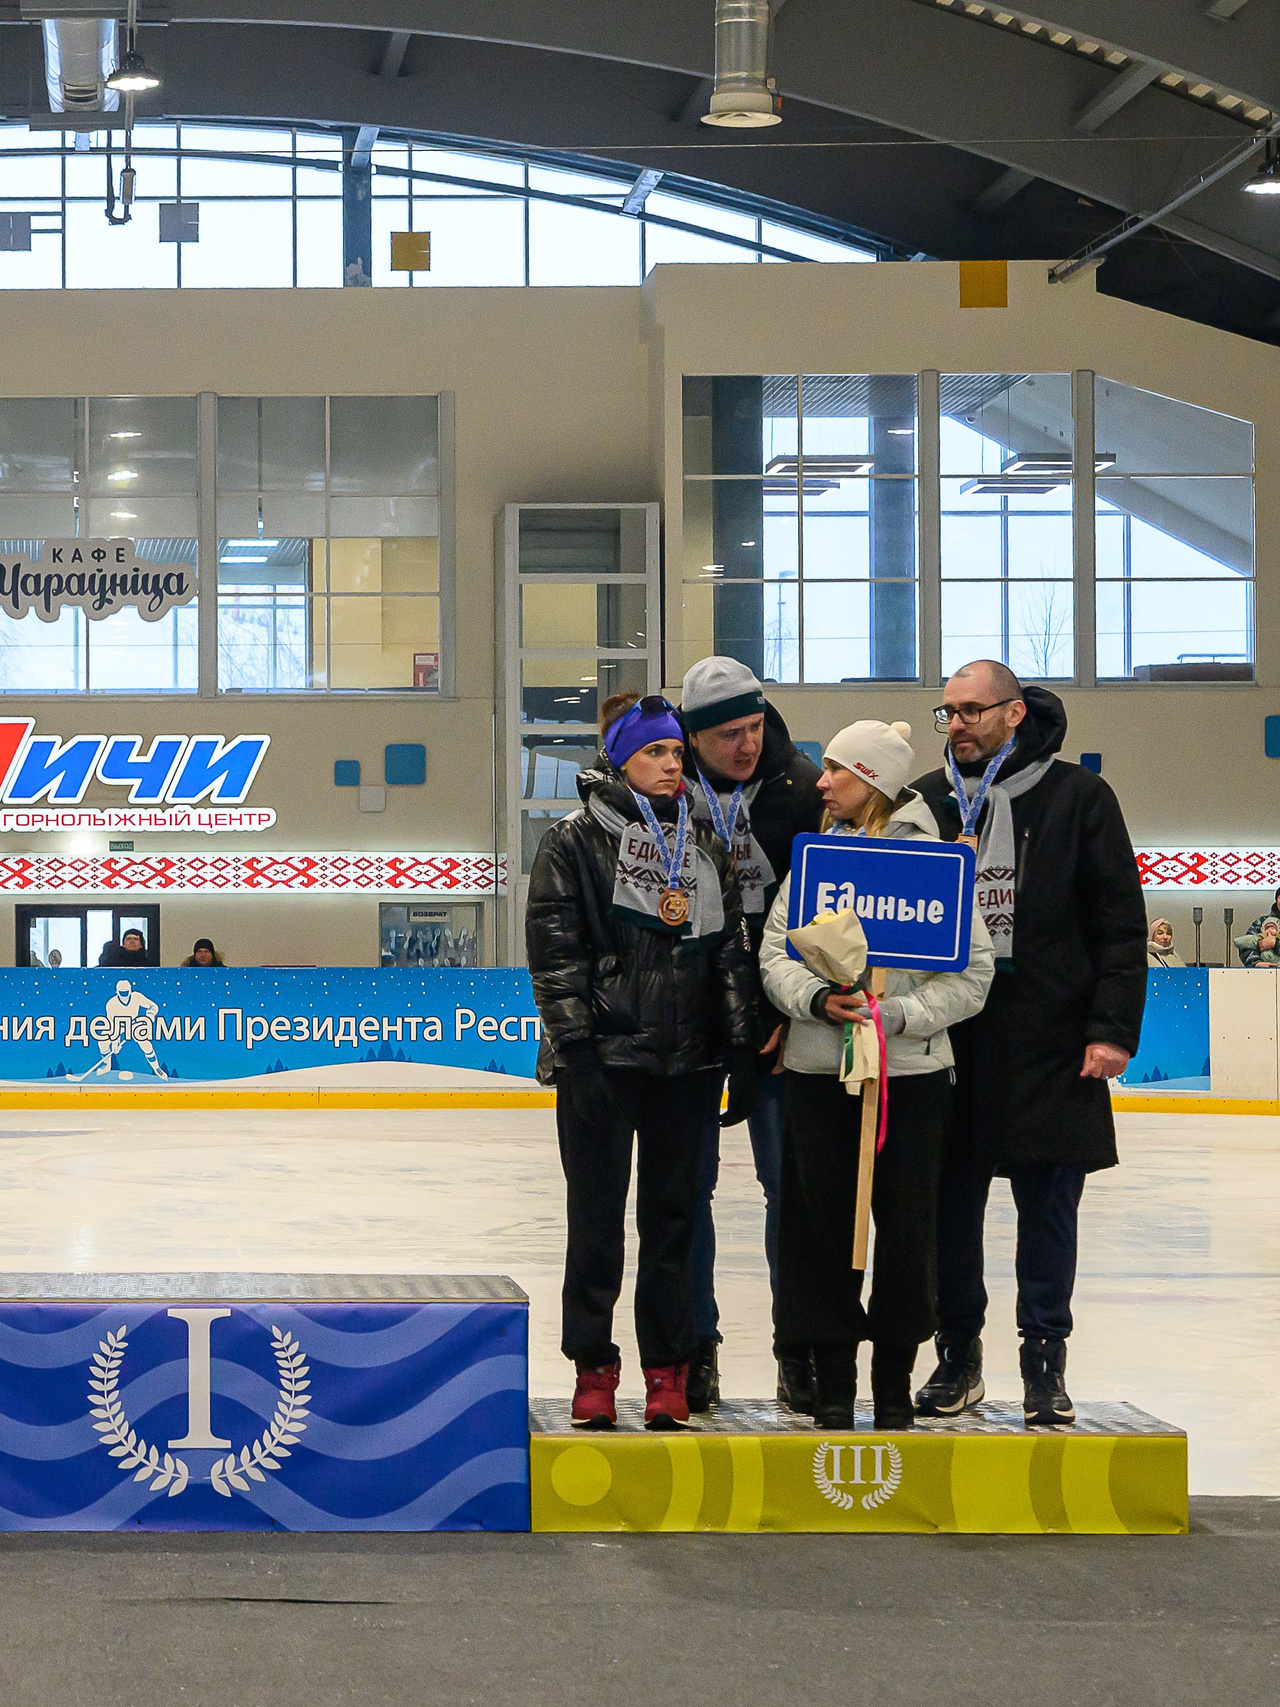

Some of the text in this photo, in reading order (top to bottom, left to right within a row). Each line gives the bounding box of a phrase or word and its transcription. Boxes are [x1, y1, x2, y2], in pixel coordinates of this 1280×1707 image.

[52, 547, 126, 563] КАФЕ
[3, 810, 191, 827] ГОРНОЛЫЖНЫЙ
[197, 813, 271, 829] ЦЕНТР
[627, 837, 691, 868] ЕДИЕ
[816, 882, 944, 924] Единые
[977, 888, 1014, 909] ЕДИ
[64, 1015, 207, 1048] делами
[217, 1007, 444, 1050] Президента
[828, 1445, 889, 1484] III
